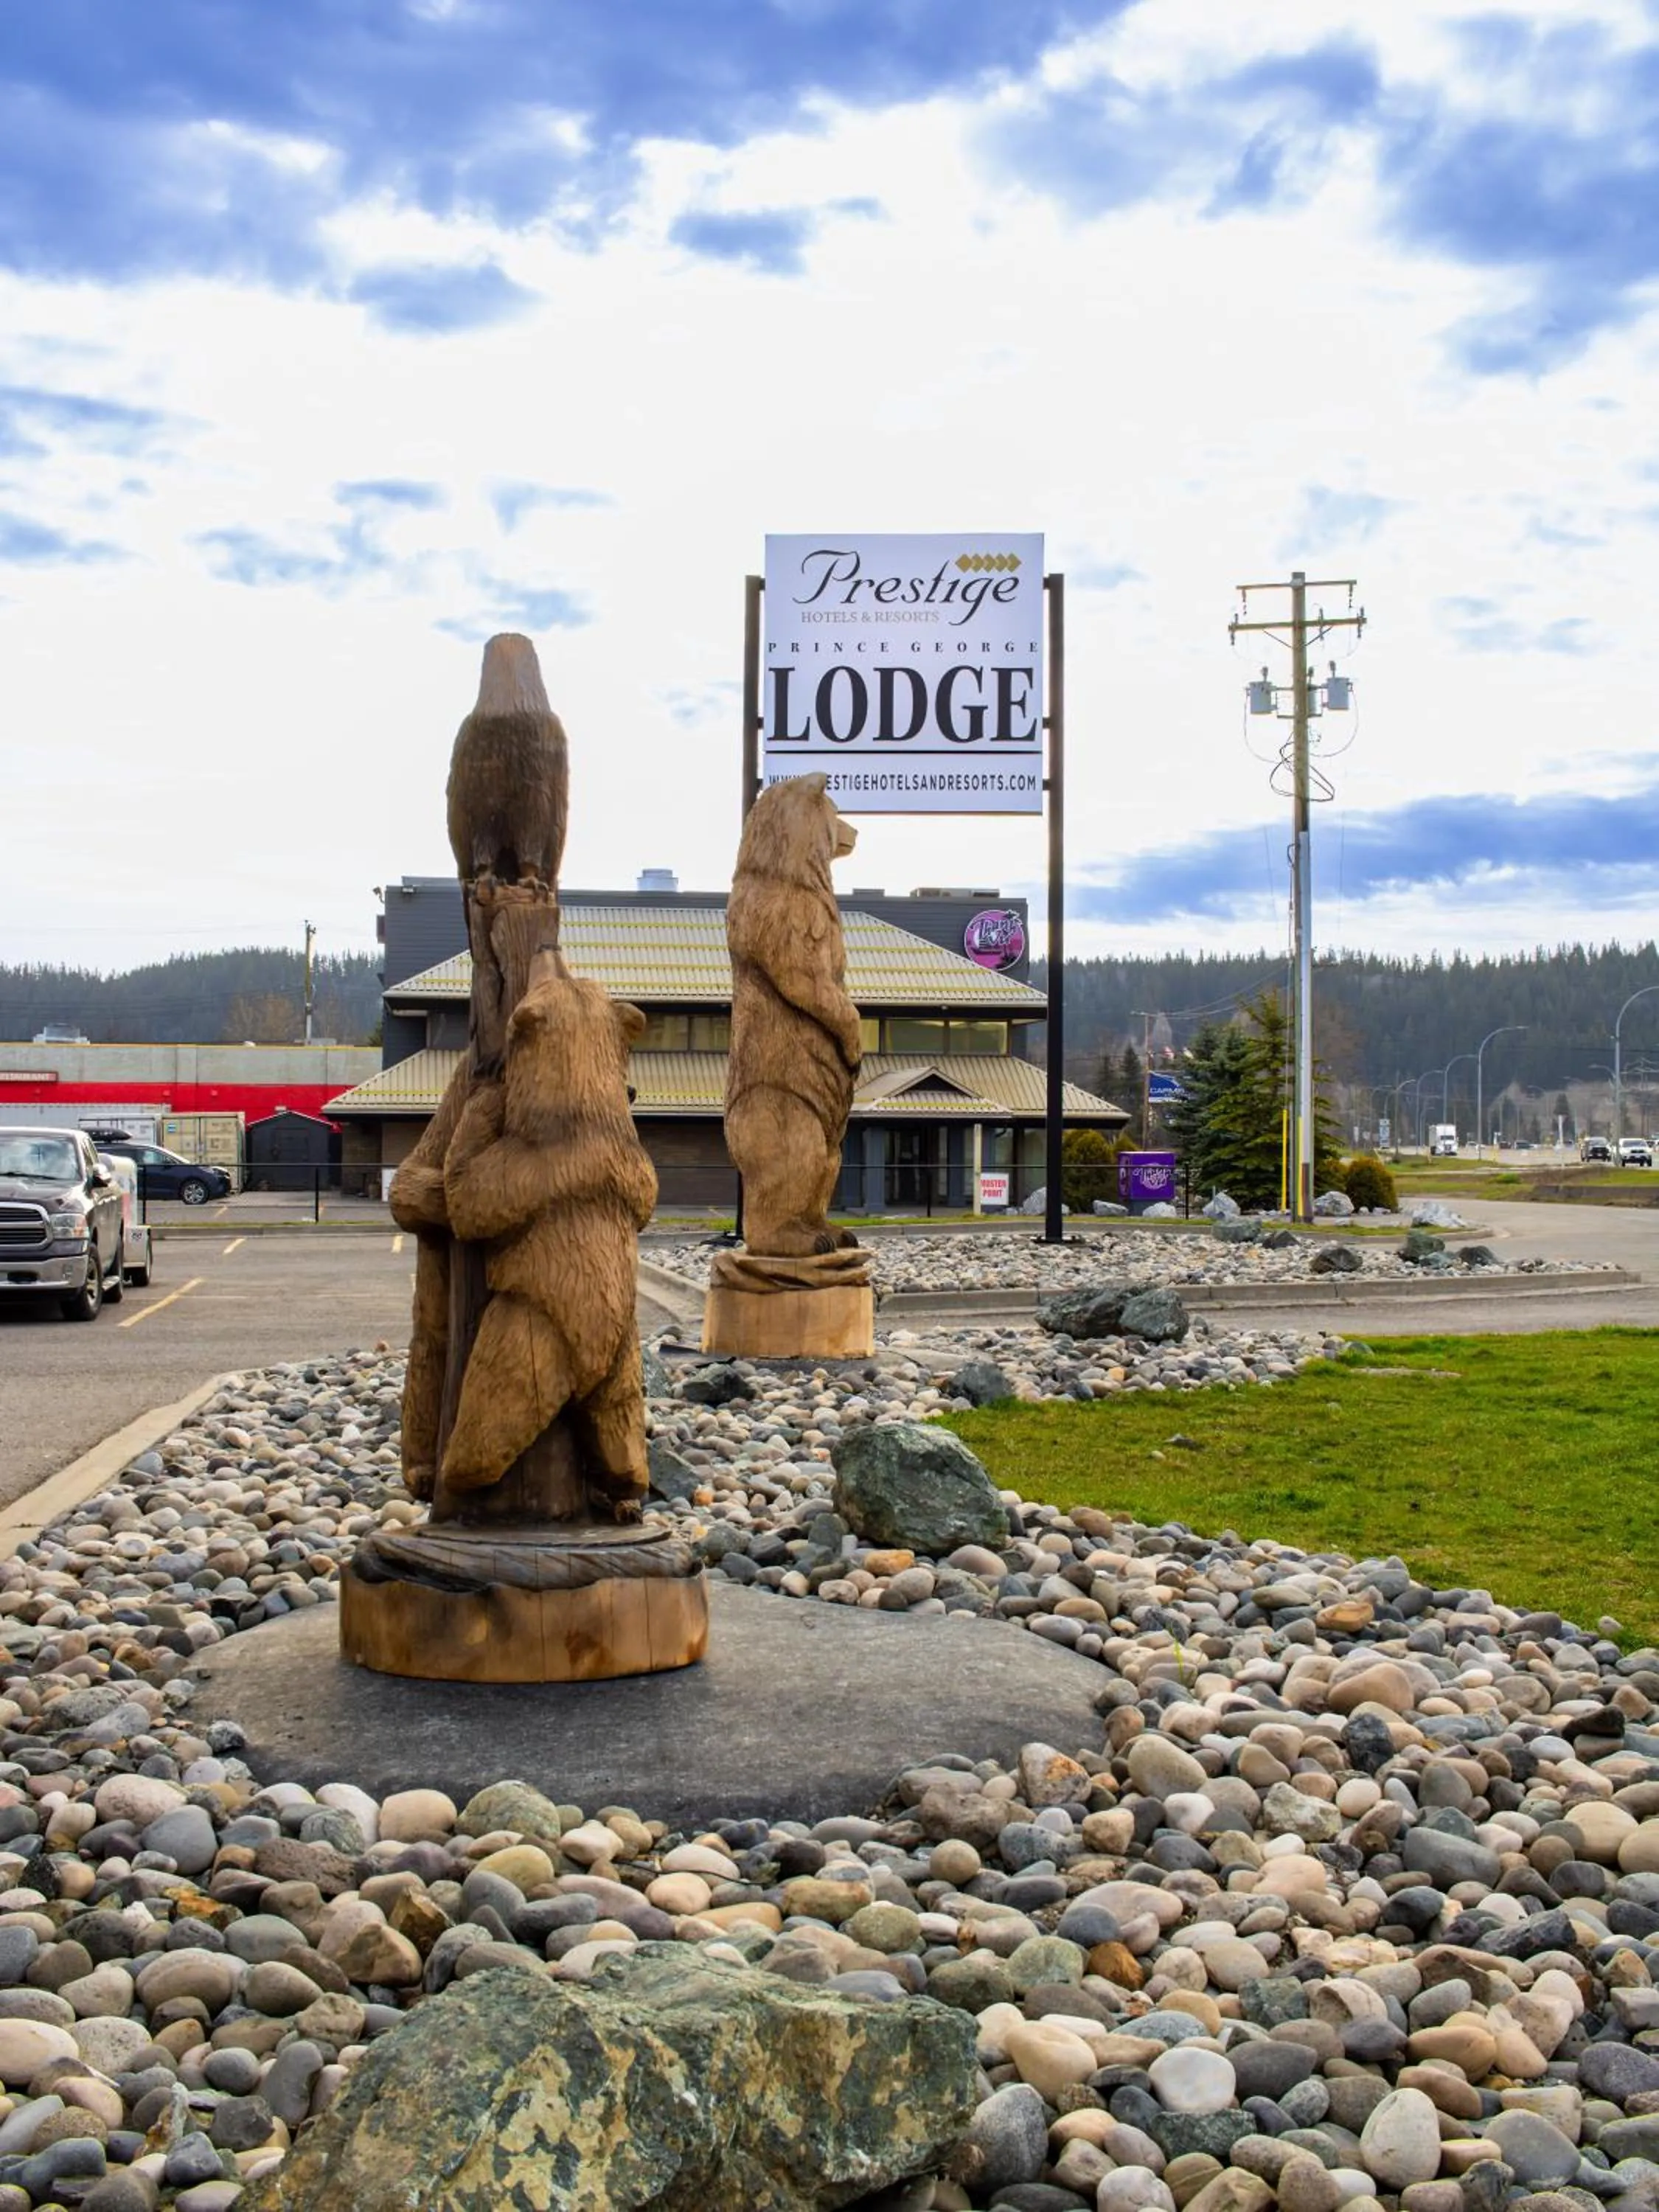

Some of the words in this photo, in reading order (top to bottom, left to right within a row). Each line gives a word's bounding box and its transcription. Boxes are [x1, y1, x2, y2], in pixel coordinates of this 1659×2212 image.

[792, 549, 1020, 626] Prestige
[801, 611, 858, 623] HOTELS
[861, 611, 872, 623] &
[875, 611, 940, 623] RESORTS
[768, 641, 889, 653] PRINCE
[911, 641, 1038, 653] GEORGE
[766, 665, 1037, 744] LODGE
